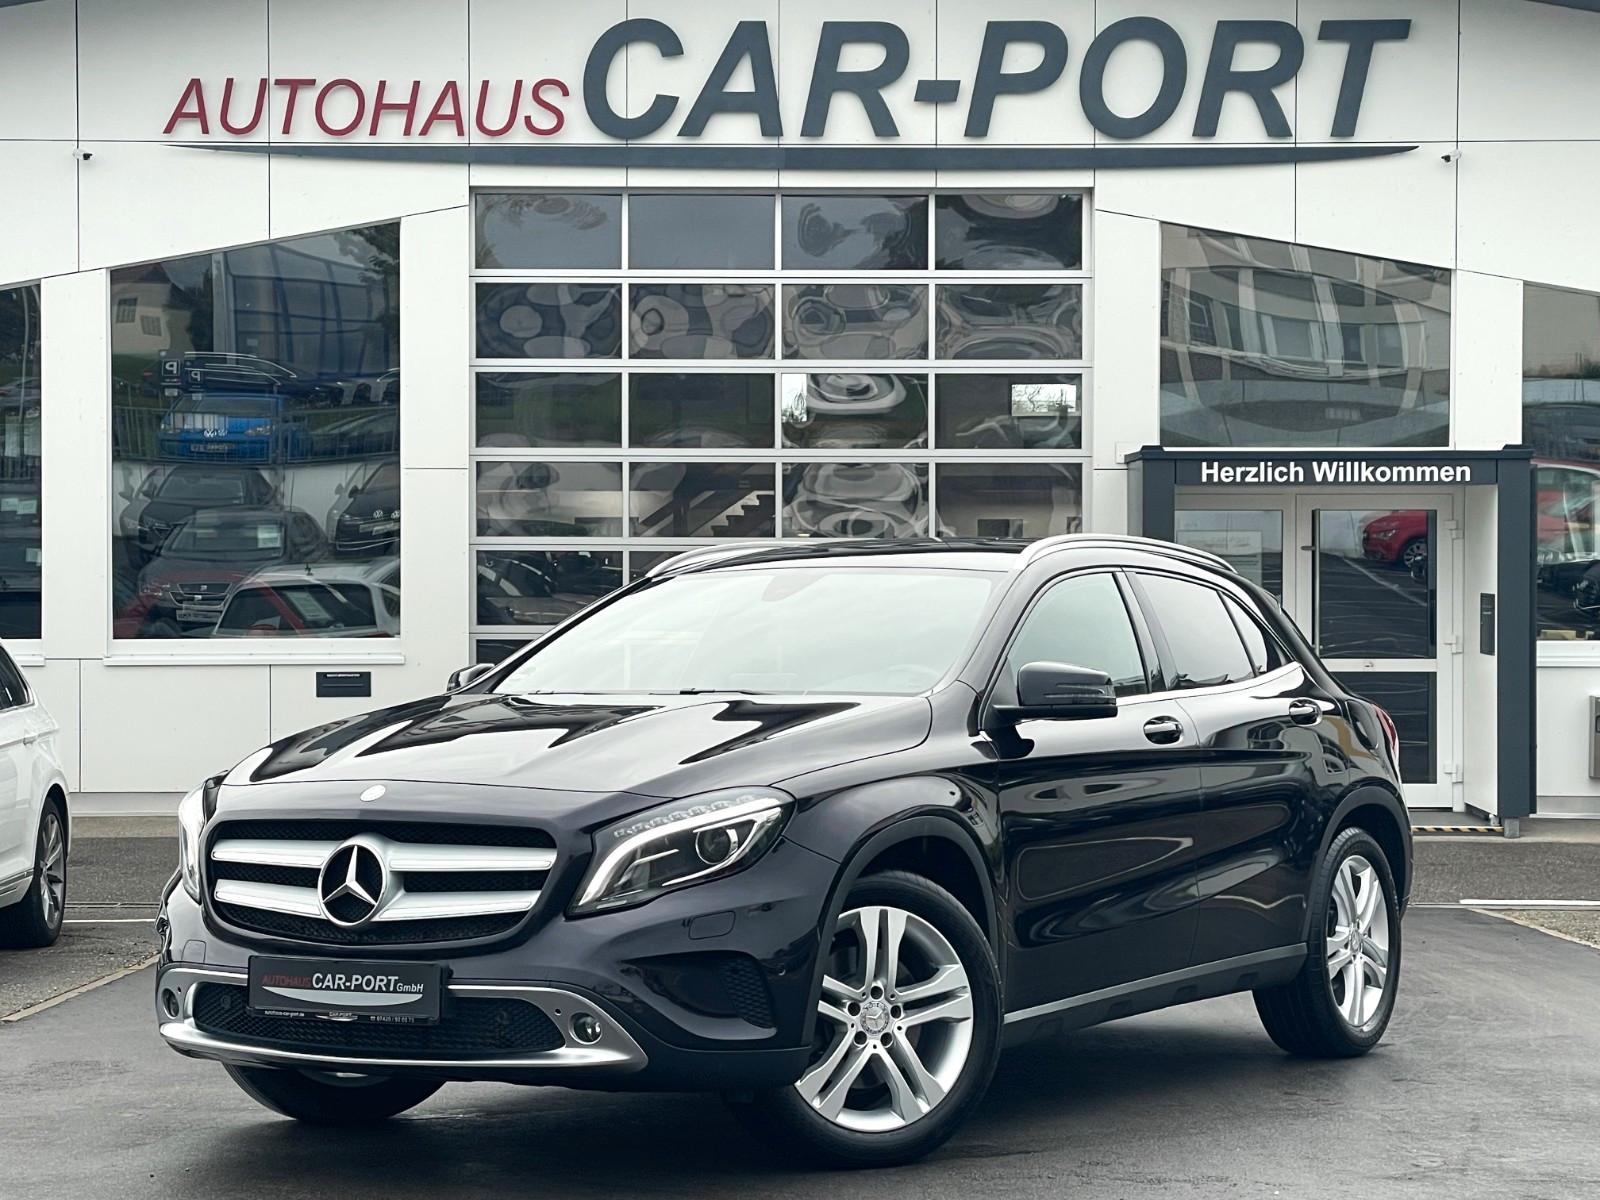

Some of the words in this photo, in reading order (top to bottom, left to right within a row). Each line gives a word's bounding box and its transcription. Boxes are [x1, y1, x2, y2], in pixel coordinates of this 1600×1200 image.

[163, 77, 570, 138] AUTOHAUS
[582, 17, 1411, 139] CAR-PORT
[1200, 461, 1304, 483] Herzlich
[1312, 461, 1471, 483] Willkommen
[262, 975, 311, 987] AUTOHAUS
[311, 973, 399, 992] CAR-PORT
[396, 982, 424, 993] GmbH
